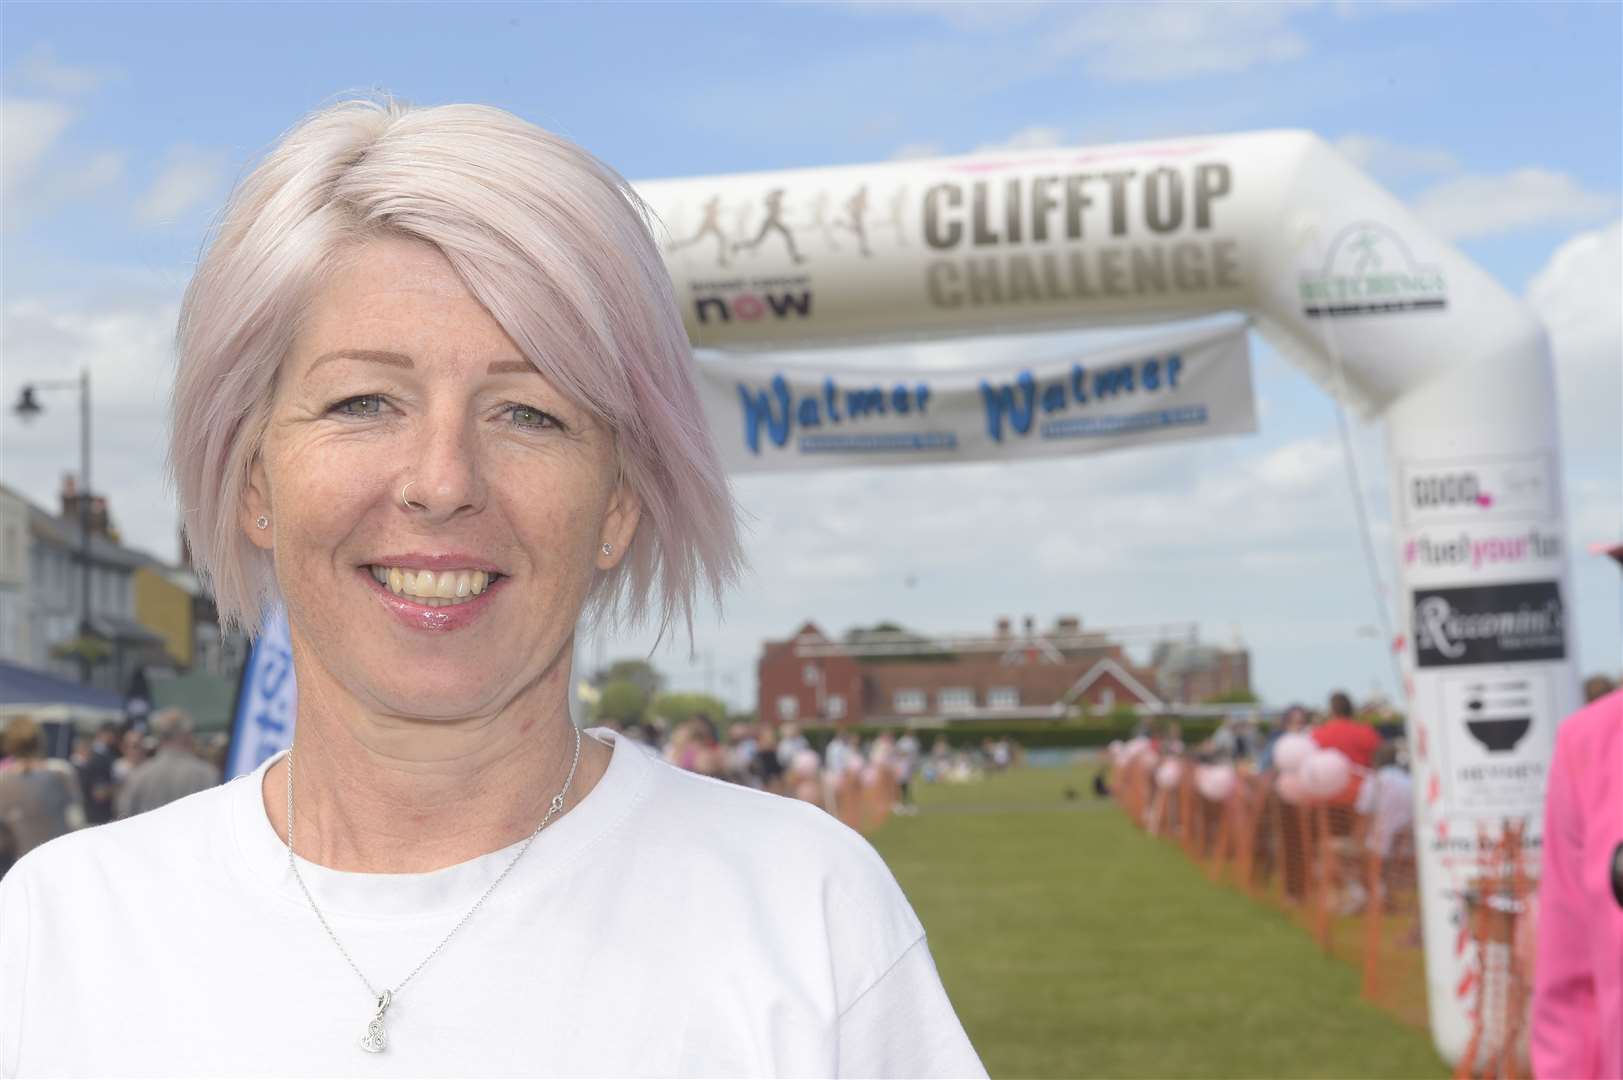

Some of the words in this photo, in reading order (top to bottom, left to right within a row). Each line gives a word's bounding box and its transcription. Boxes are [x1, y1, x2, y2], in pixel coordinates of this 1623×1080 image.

[923, 163, 1232, 251] CLIFFTOP
[695, 289, 812, 322] now
[927, 239, 1241, 309] CHALLENGE
[737, 374, 930, 456] Walmer
[980, 354, 1182, 442] Walmer
